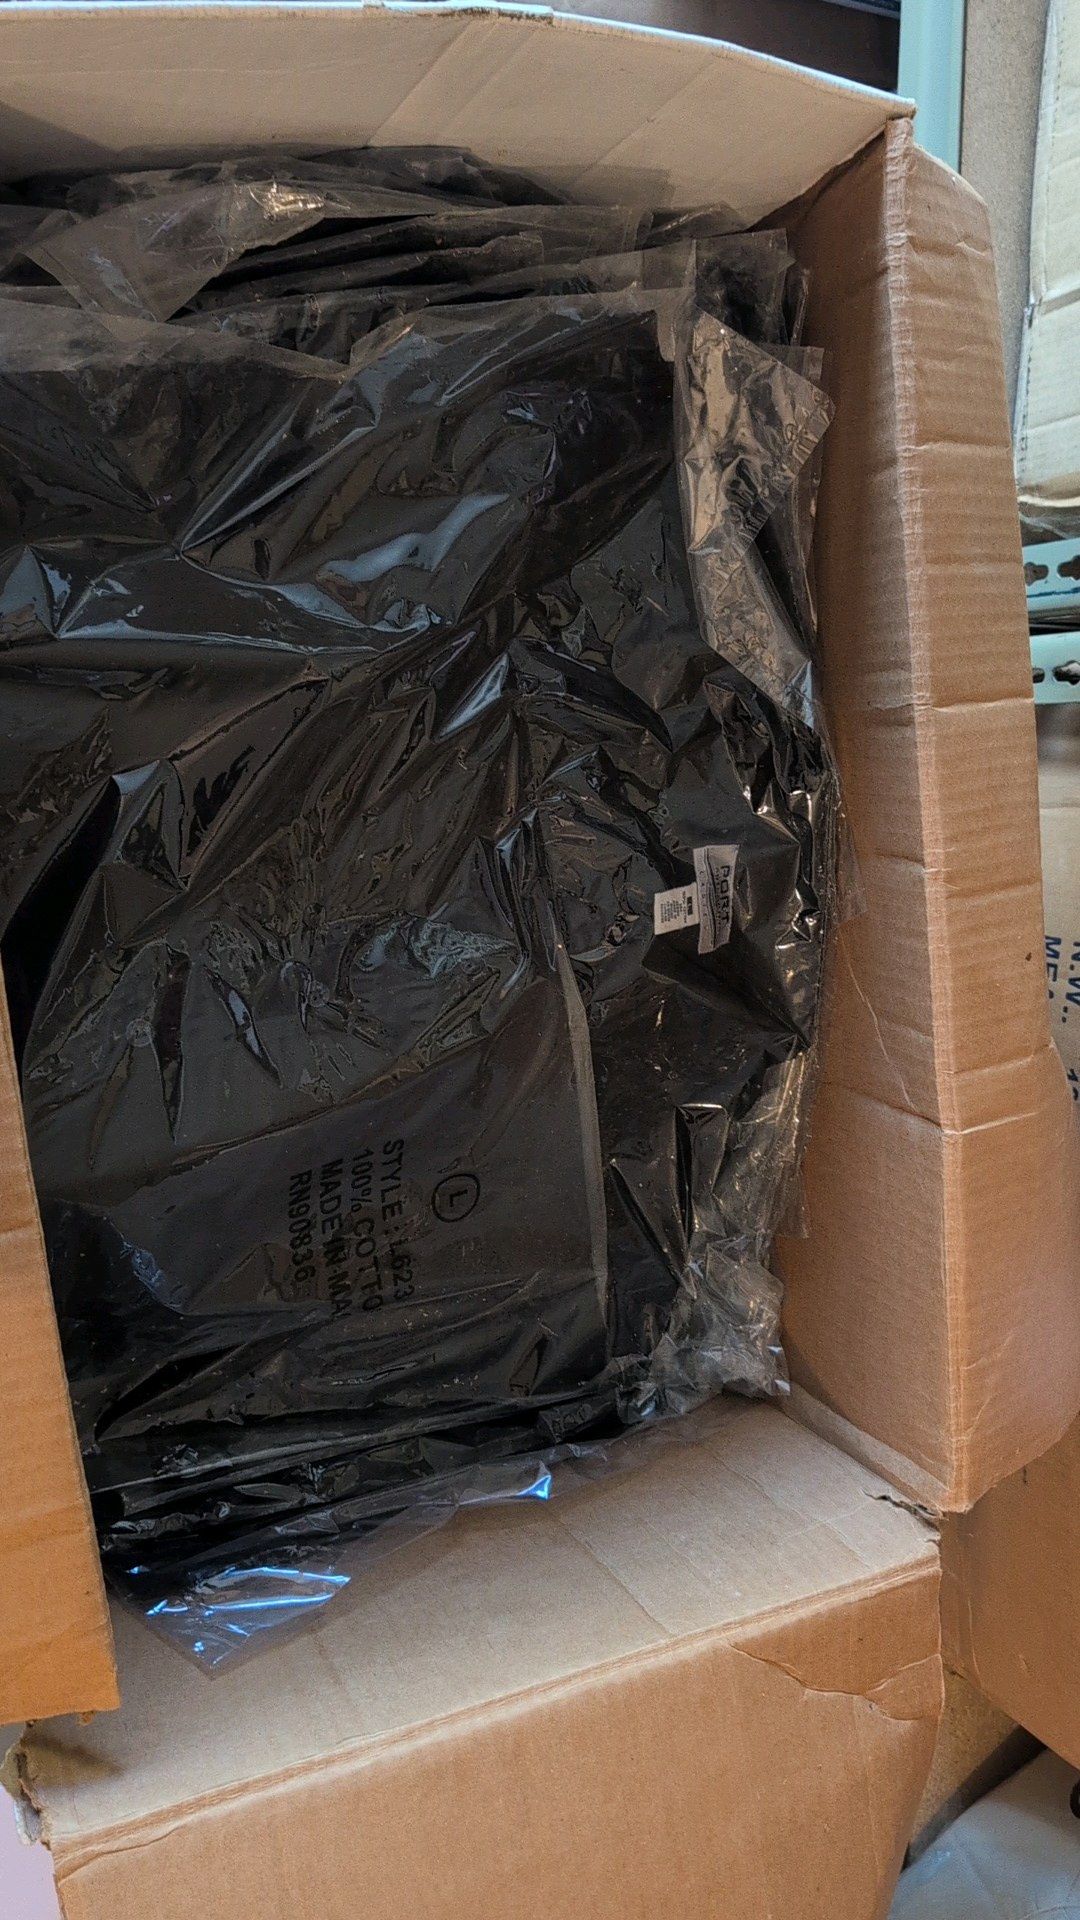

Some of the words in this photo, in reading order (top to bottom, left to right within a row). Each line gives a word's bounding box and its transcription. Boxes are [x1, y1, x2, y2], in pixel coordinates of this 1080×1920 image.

[720, 865, 731, 923] PORT
[319, 1158, 344, 1236] MADE
[351, 1148, 374, 1214] 100%
[287, 1169, 316, 1283] RN90836
[322, 1236, 347, 1268] IN
[328, 1269, 353, 1318] MA
[353, 1216, 384, 1312] COTTO
[389, 1237, 415, 1301] L623
